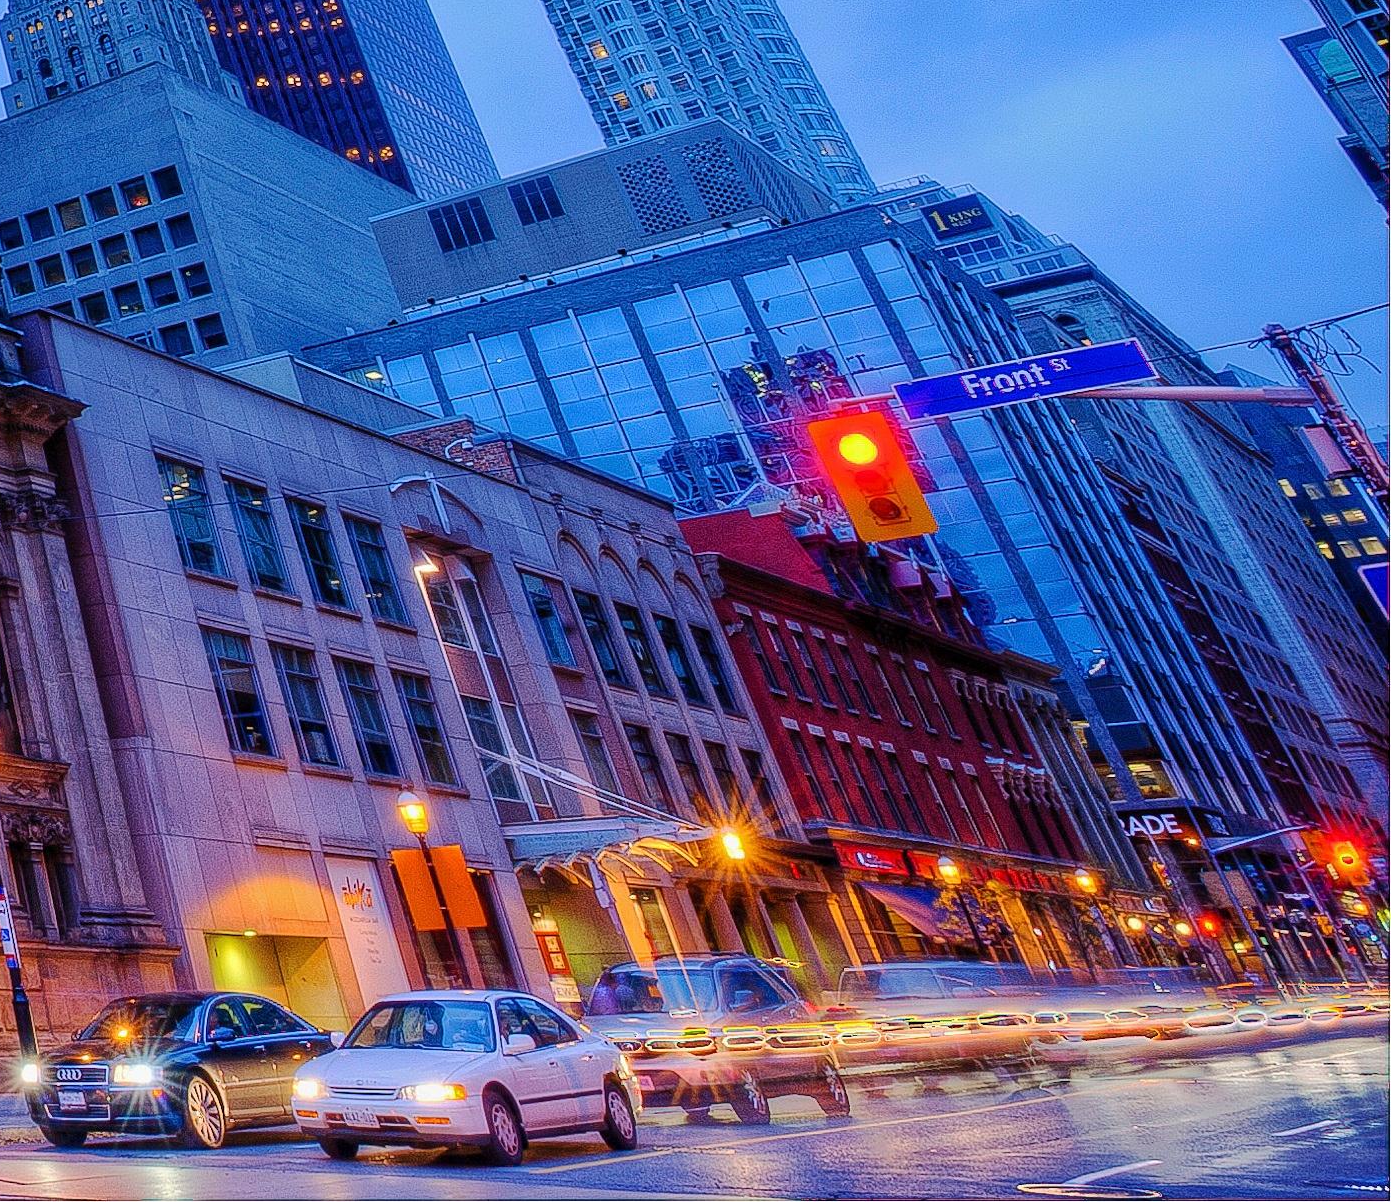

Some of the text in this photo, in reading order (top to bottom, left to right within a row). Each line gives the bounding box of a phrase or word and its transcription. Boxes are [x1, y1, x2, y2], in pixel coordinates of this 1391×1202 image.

[928, 207, 983, 231] 1 KING
[959, 357, 1071, 399] Front St
